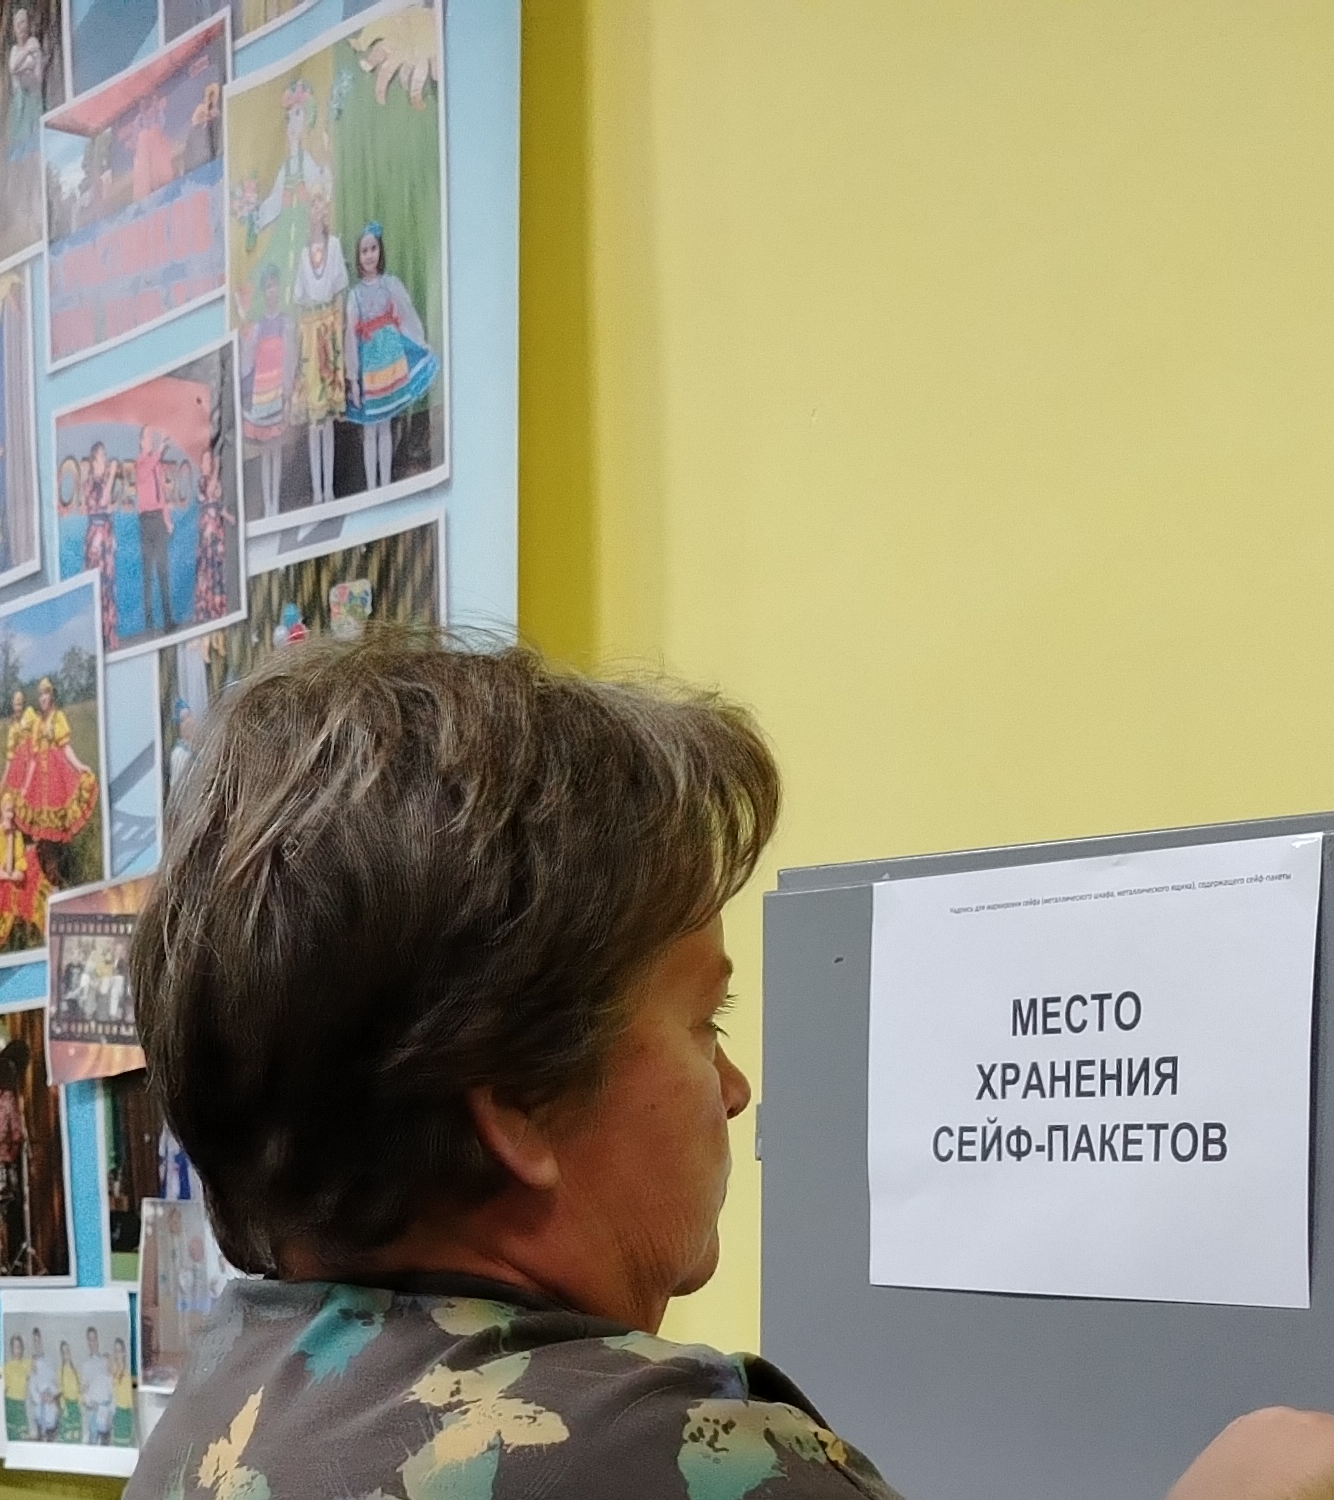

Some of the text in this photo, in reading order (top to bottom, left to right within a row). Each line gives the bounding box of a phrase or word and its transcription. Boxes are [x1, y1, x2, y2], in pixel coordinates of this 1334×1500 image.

[1011, 990, 1142, 1036] МЕСТО
[975, 1055, 1179, 1100] ХРАНЕНИЯ
[931, 1116, 1228, 1162] СЕЙФ-ПАКЕТОВ
